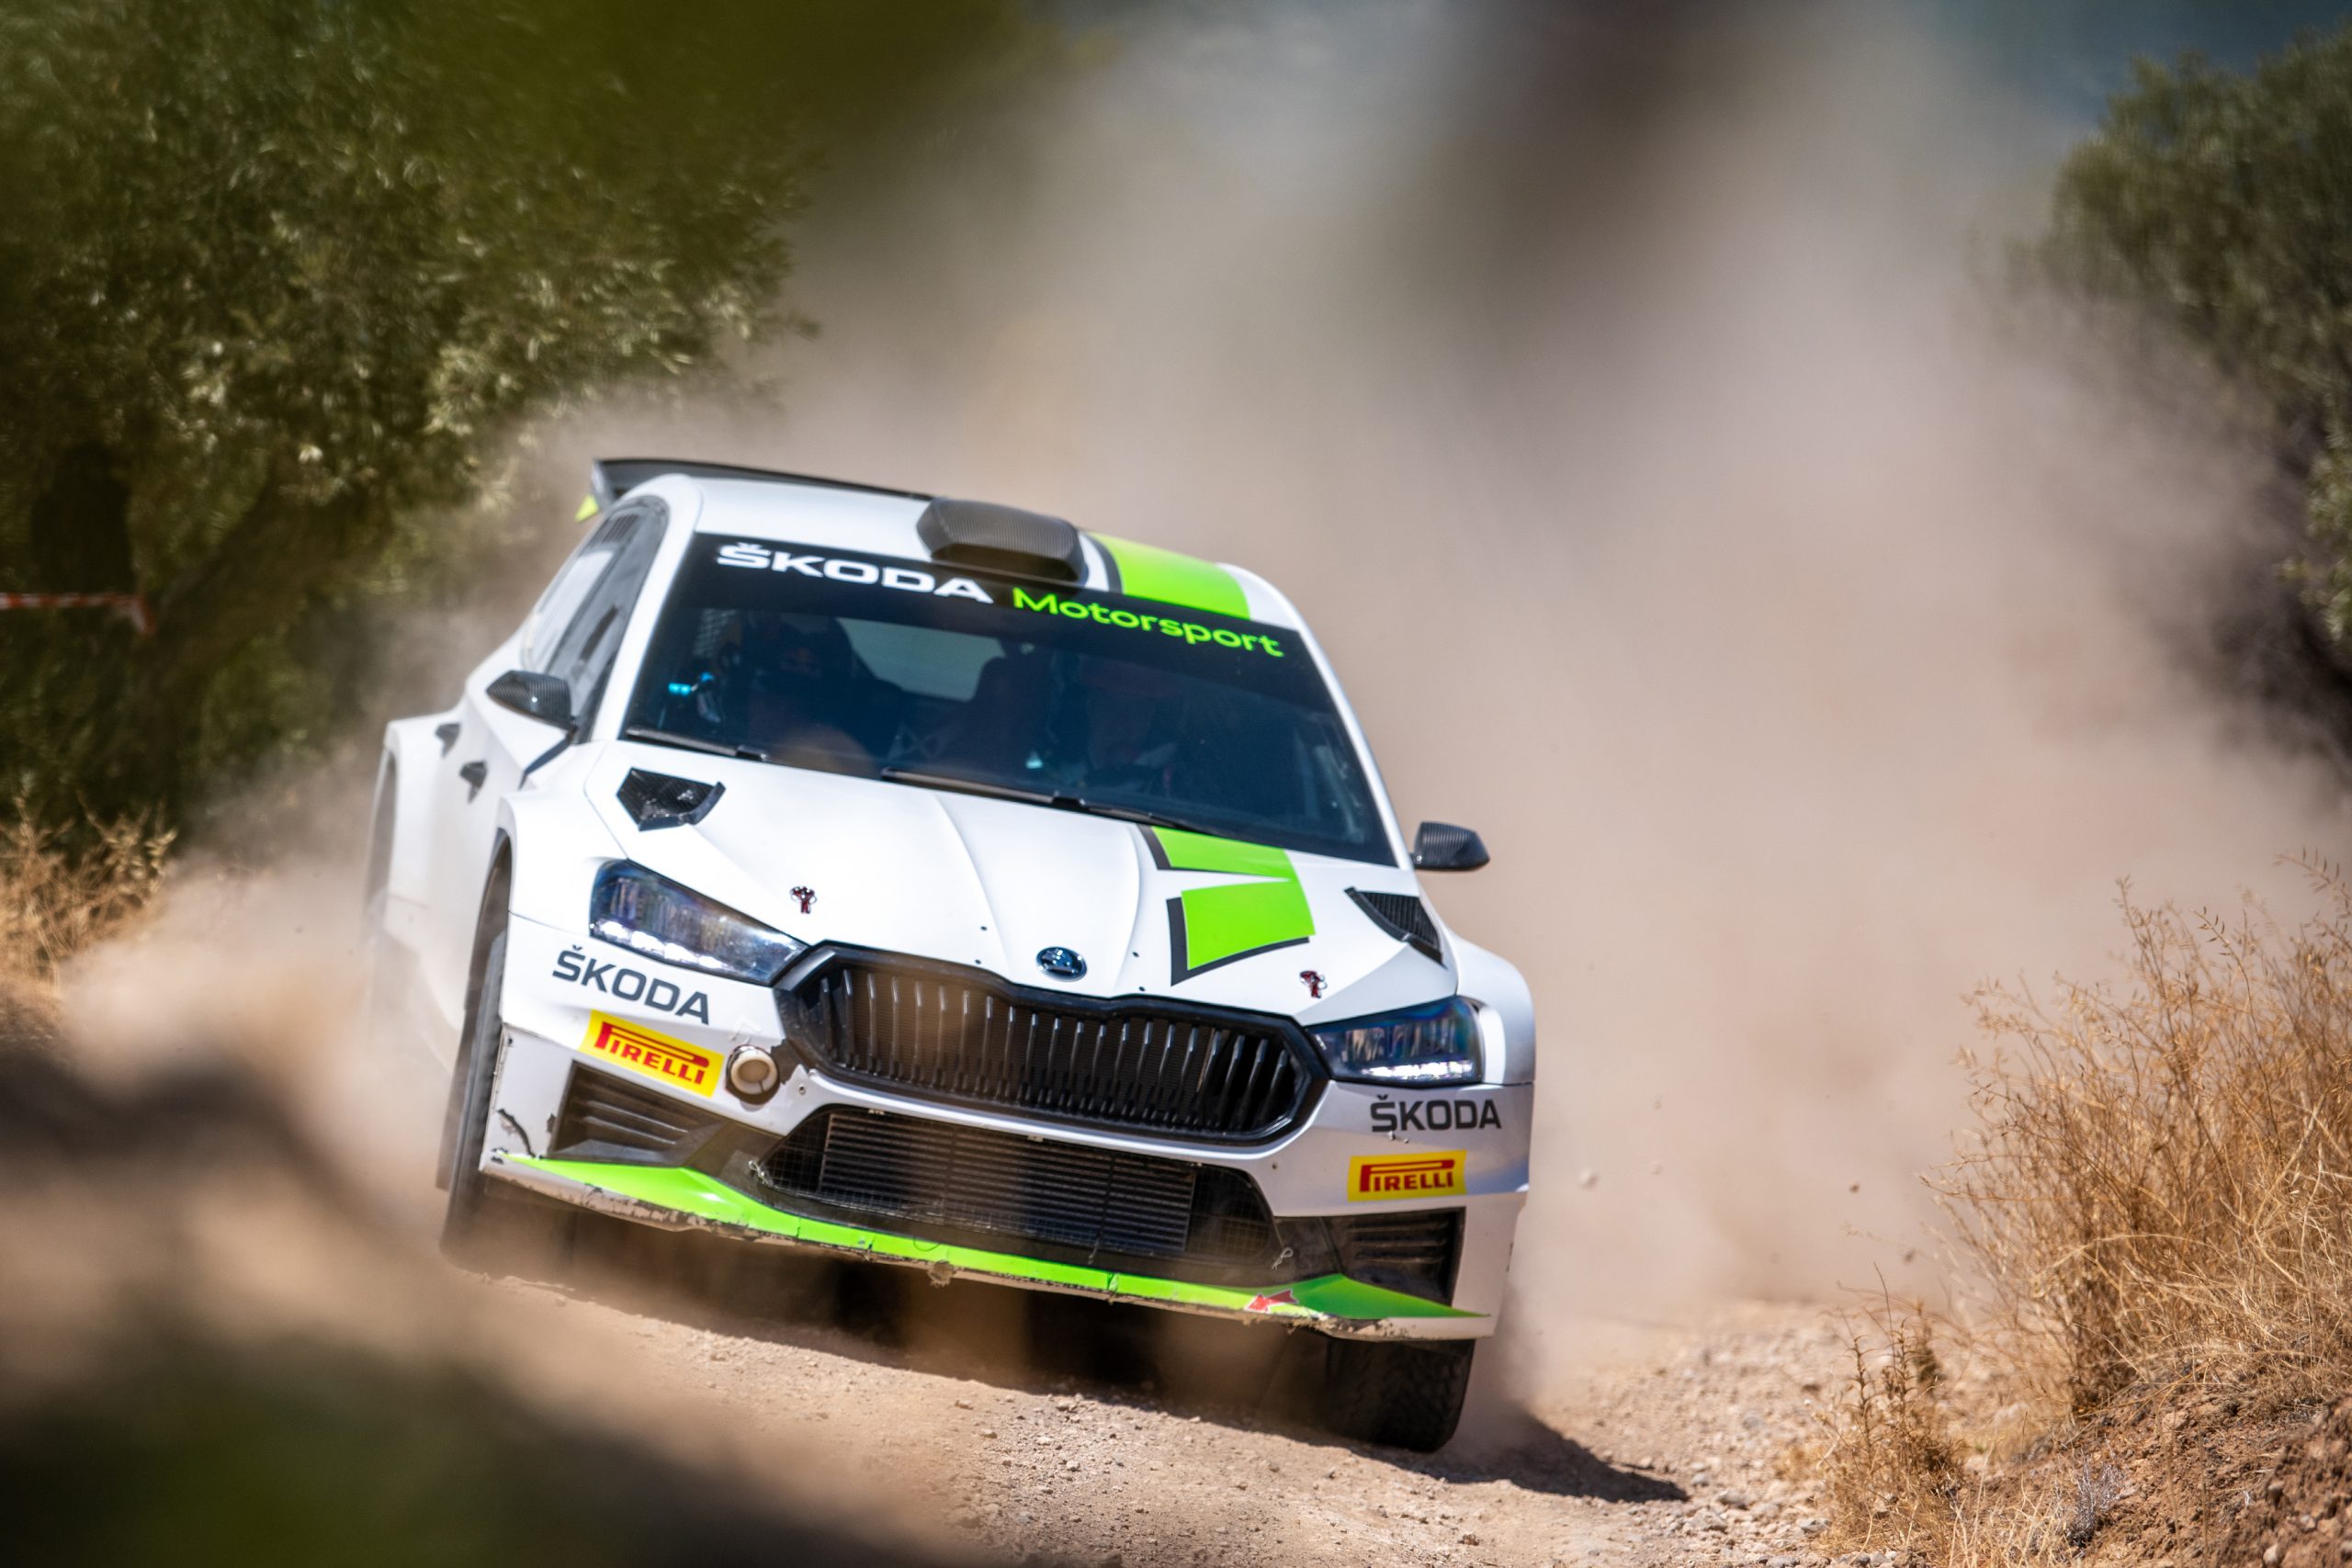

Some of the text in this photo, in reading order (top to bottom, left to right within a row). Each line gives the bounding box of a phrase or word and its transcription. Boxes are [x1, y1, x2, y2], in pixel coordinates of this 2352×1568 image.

[717, 542, 1284, 658] ŠKODA Motorsport
[553, 945, 710, 1024] ŠKODA
[594, 1021, 710, 1086] PIRELLI
[1370, 1095, 1502, 1133] ŠKODA
[1360, 1159, 1456, 1192] PIRELLI
